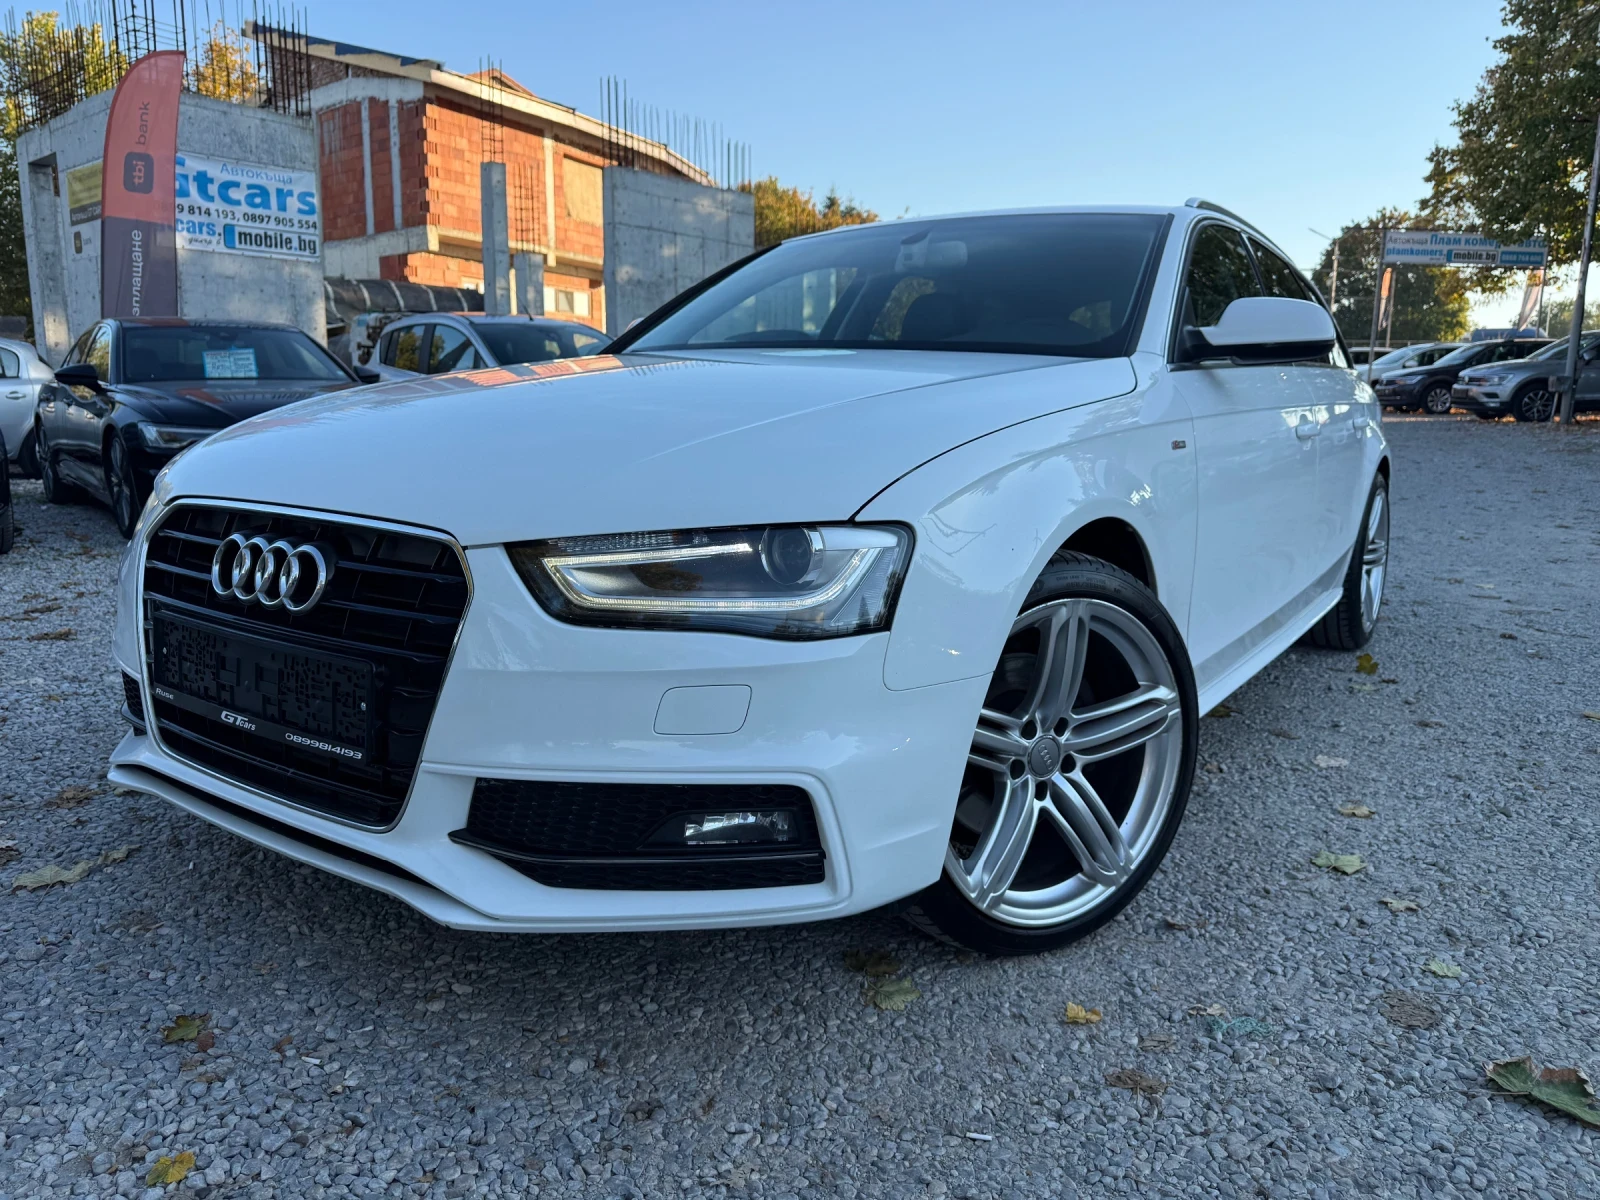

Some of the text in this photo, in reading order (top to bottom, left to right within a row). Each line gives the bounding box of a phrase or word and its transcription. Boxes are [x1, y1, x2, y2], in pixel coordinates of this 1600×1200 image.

[132, 101, 150, 186] tbi bank
[220, 162, 293, 185] Автокъща
[187, 205, 211, 217] 814
[214, 208, 240, 222] 193,
[242, 212, 271, 225] 0897
[274, 215, 295, 229] 905
[297, 218, 318, 231] 554
[238, 230, 317, 255] mobile.bg
[1430, 233, 1462, 246] Плам
[1453, 250, 1497, 263] mobile.bg
[285, 732, 363, 760] 0899814193
